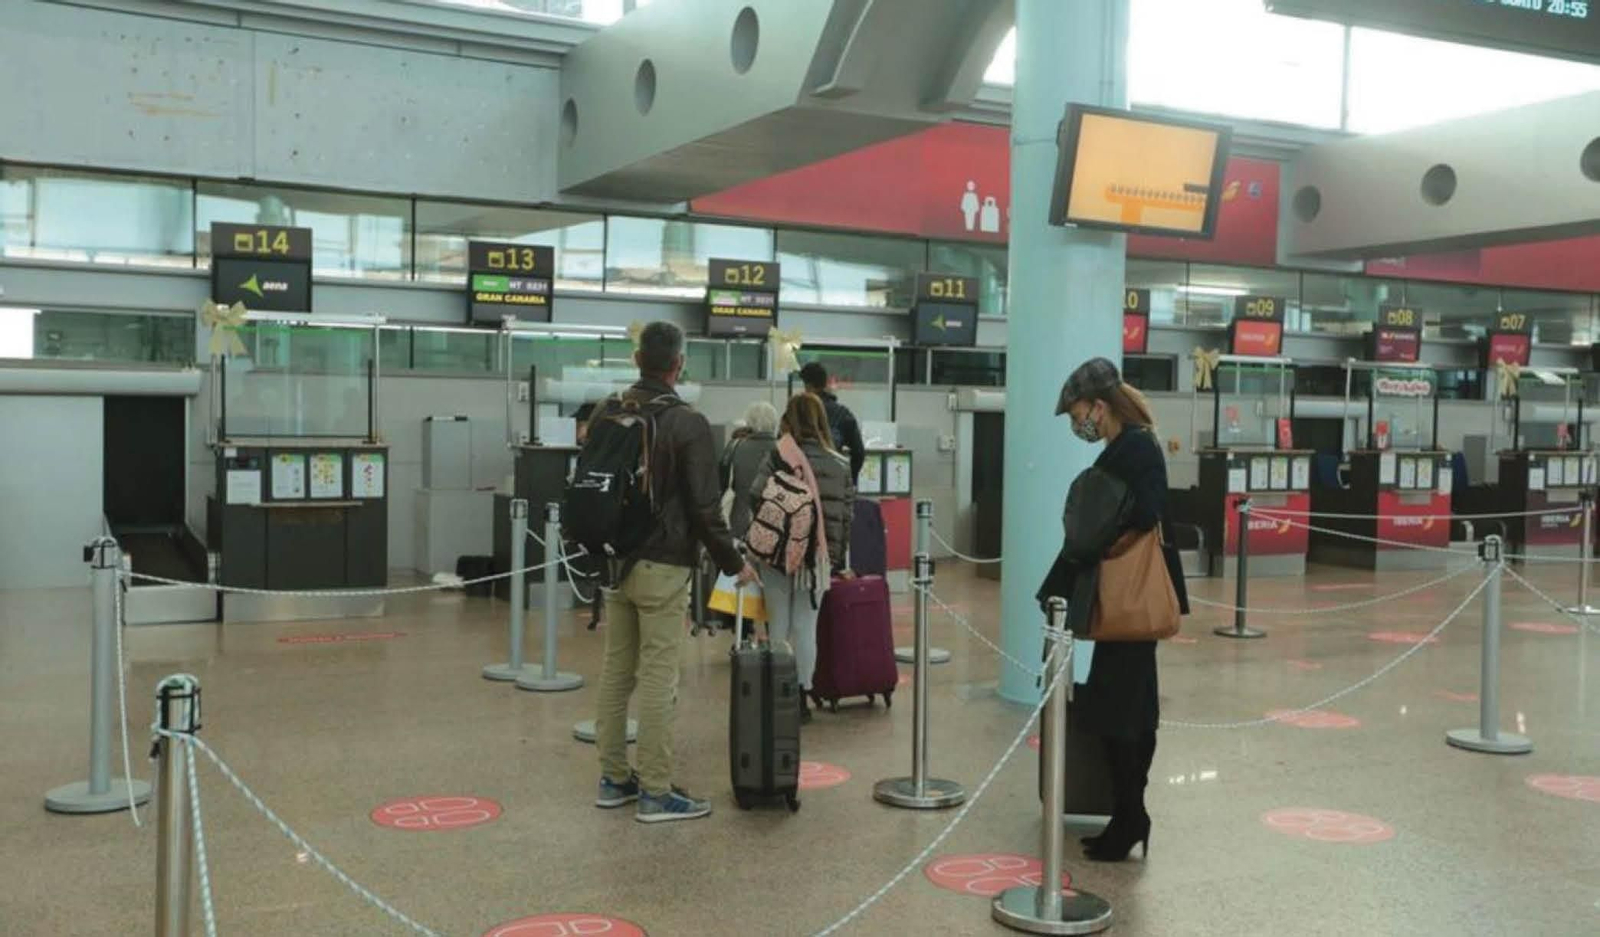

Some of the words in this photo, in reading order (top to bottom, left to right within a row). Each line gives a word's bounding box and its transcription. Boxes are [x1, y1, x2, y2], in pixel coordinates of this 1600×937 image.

[1547, 0, 1587, 18] 20:55
[257, 229, 289, 254] 14
[506, 248, 535, 270] 13
[741, 264, 766, 285] 12
[262, 282, 288, 291] aena
[944, 279, 965, 298] 11
[475, 292, 503, 302] GRAN
[504, 294, 546, 305] CANARIA
[1124, 290, 1139, 310] 0
[1256, 299, 1275, 317] 09
[1398, 309, 1413, 326] 08
[1511, 314, 1526, 330] 07
[1247, 519, 1278, 531] BERIA
